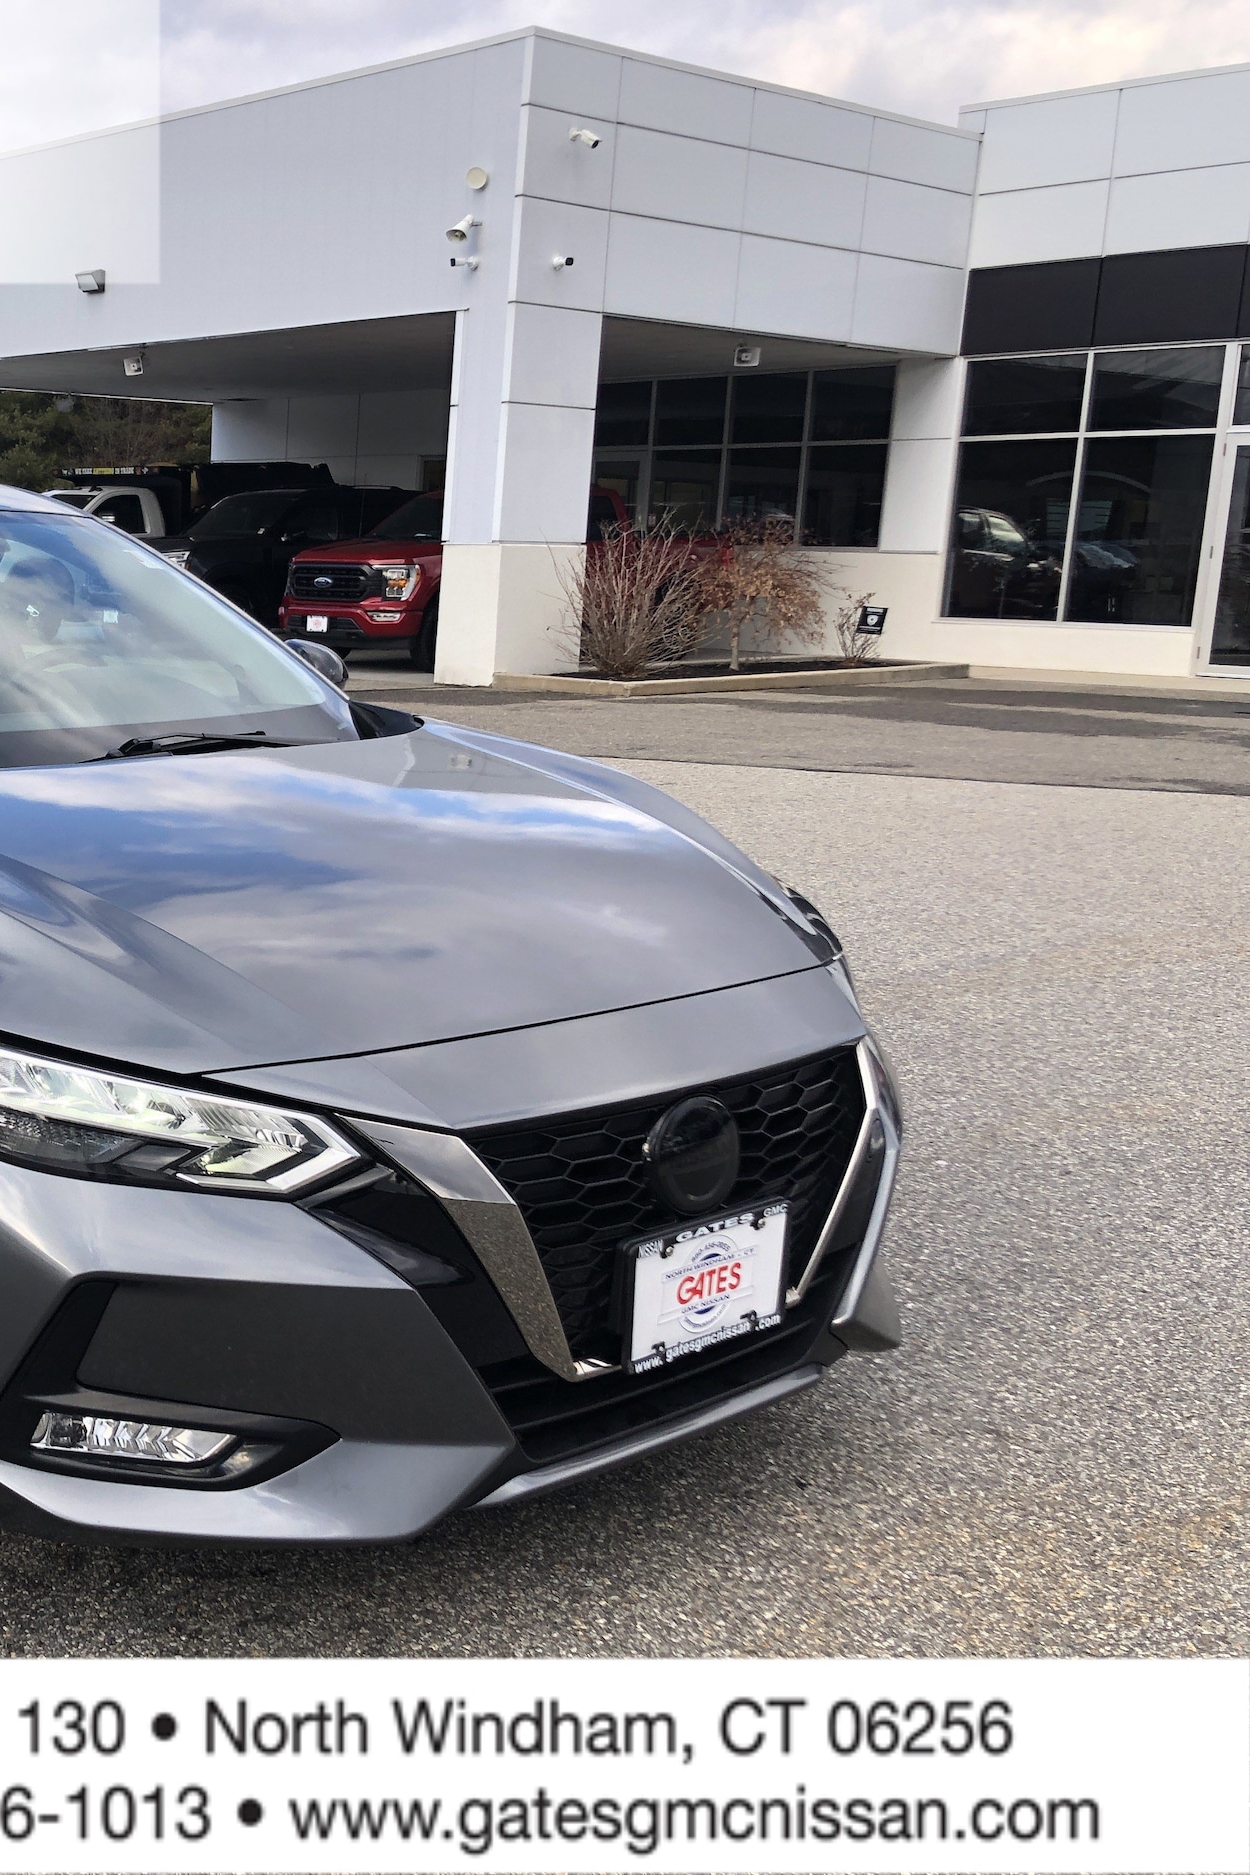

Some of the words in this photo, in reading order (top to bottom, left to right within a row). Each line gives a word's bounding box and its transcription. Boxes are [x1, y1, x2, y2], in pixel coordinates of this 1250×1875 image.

[637, 1239, 664, 1259] NISSAN
[675, 1212, 755, 1243] GATES
[763, 1203, 789, 1218] GMC
[676, 1262, 742, 1305] GATES
